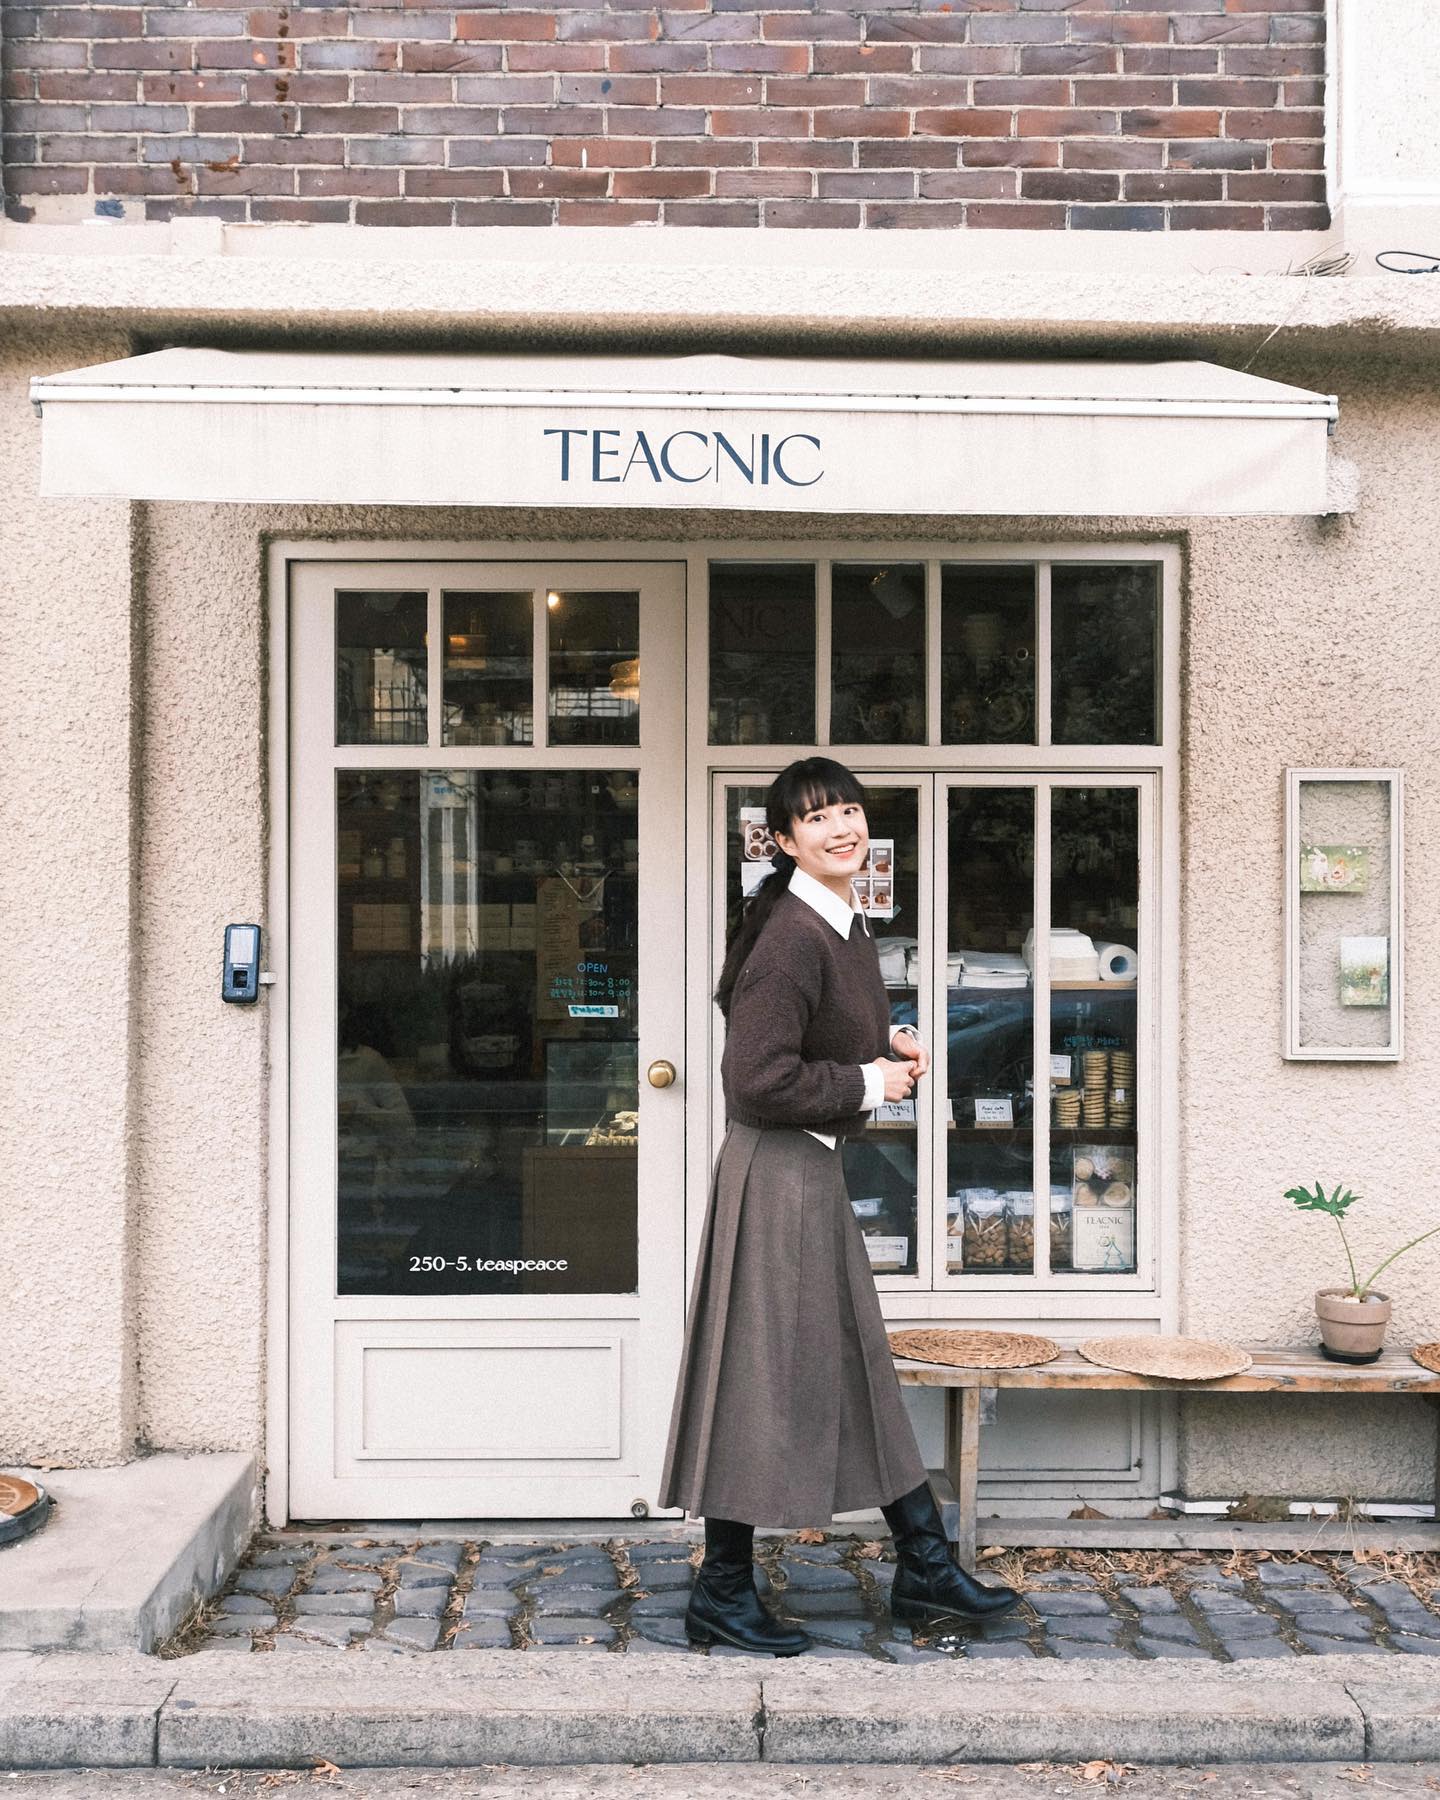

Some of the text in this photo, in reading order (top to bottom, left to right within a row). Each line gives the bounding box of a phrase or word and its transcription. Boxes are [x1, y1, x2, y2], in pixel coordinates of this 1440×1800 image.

[543, 429, 825, 486] TEACNIC
[576, 962, 608, 973] OPEN
[1084, 1216, 1124, 1225] TEACNIC
[409, 1256, 568, 1275] 250-5. teaspeace
